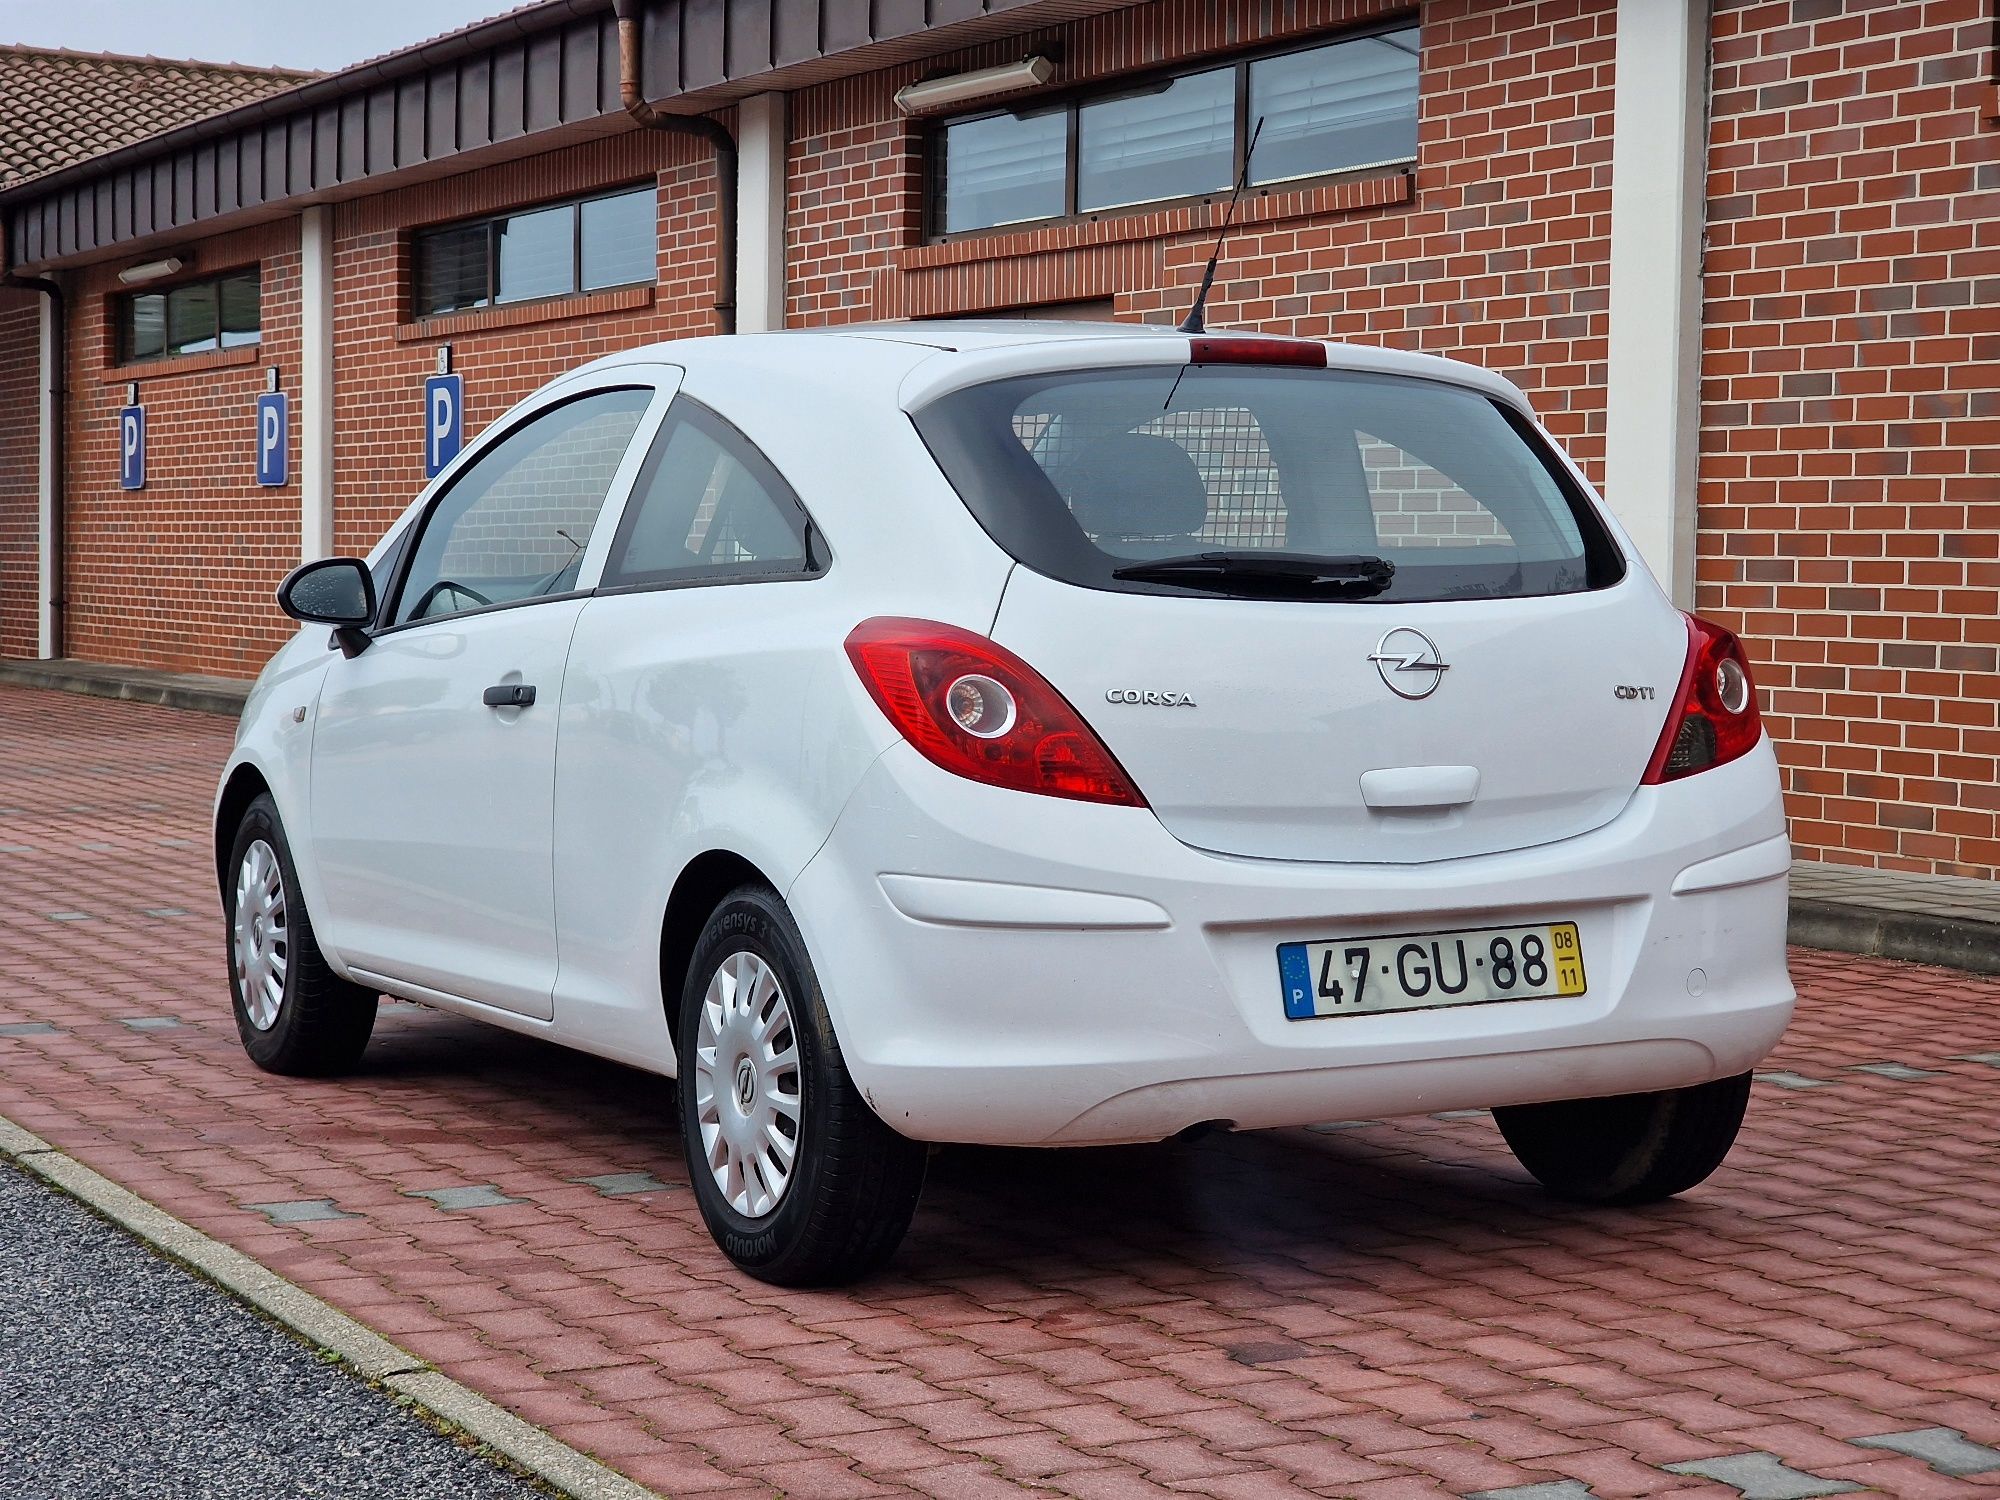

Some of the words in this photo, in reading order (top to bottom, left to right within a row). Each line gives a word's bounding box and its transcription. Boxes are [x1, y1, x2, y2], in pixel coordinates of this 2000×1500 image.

[432, 387, 452, 467] P
[124, 416, 138, 479] P
[262, 406, 279, 474] P
[1105, 688, 1197, 707] CORSA
[1614, 685, 1655, 700] CDTI
[1554, 931, 1573, 949] 08
[1561, 968, 1577, 986] 11
[1292, 989, 1304, 1005] P
[725, 1228, 778, 1258] Norauto
